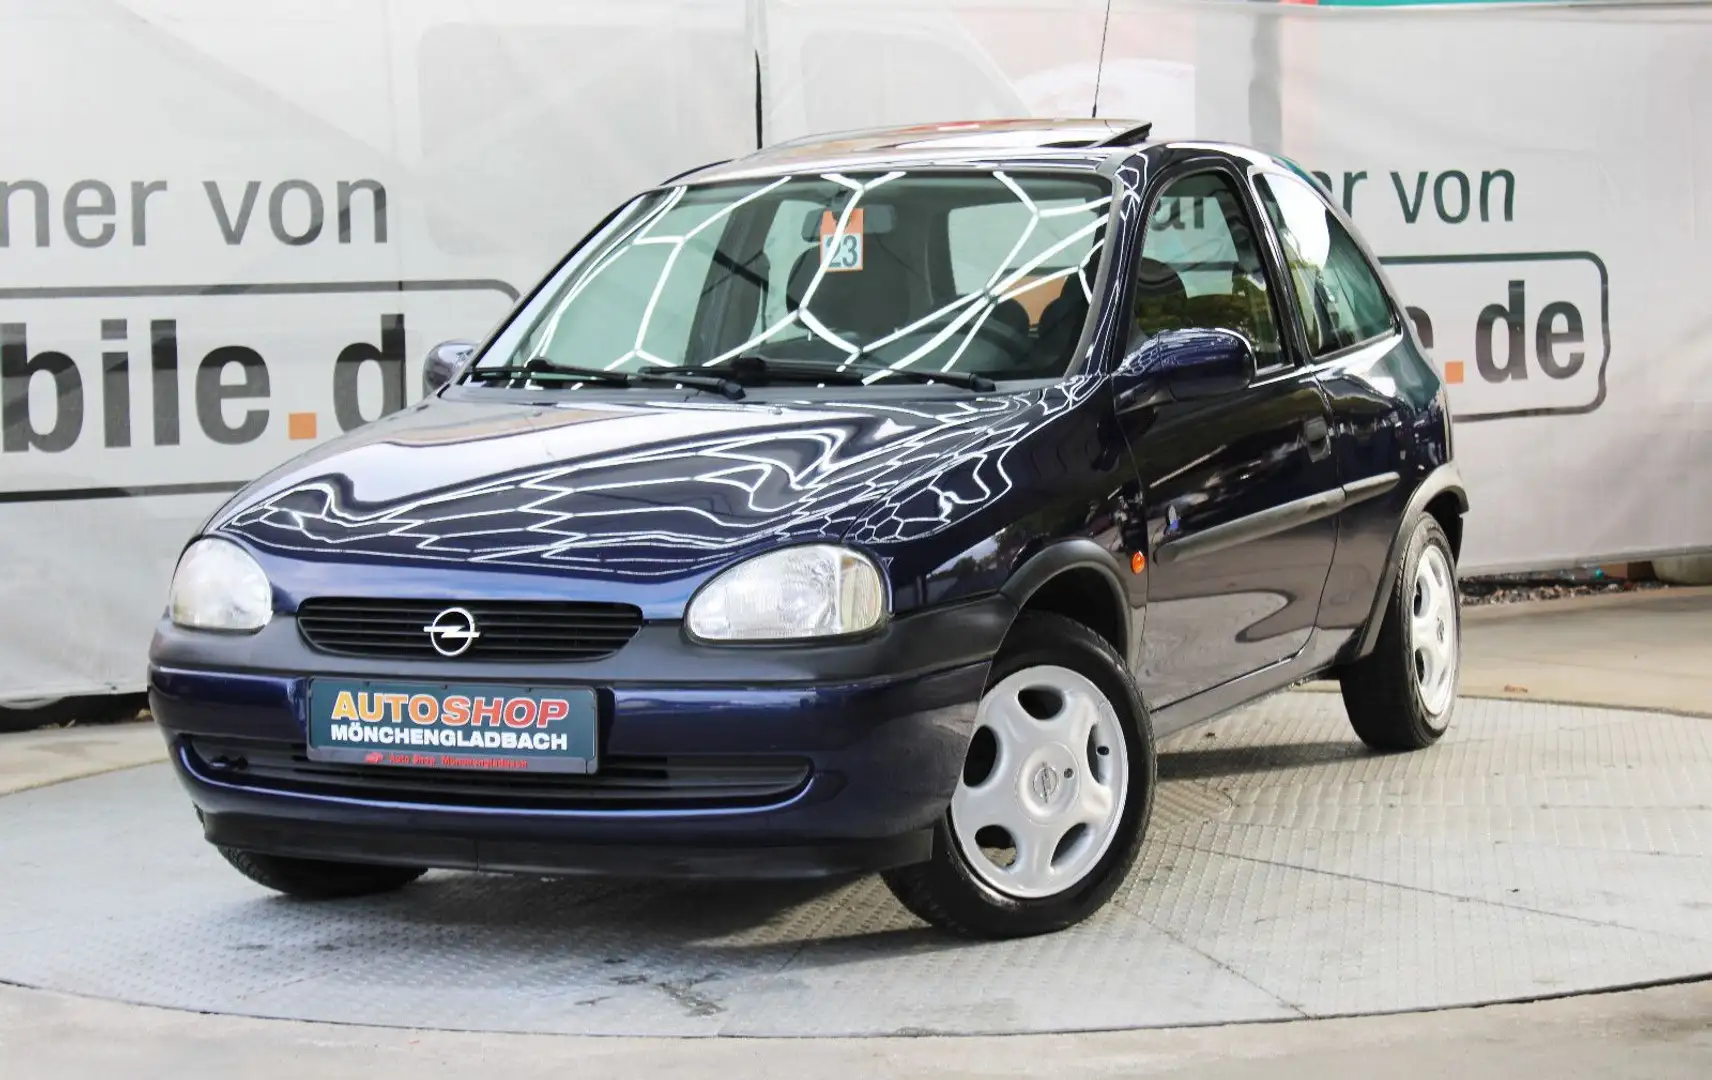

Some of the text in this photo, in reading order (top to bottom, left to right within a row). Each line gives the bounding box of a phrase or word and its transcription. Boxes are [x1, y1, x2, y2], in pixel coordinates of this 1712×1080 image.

[0, 178, 388, 248] ner von
[1389, 168, 1516, 225] von
[826, 234, 858, 267] 23
[331, 721, 568, 750] MÖNCHENGLADBACH
